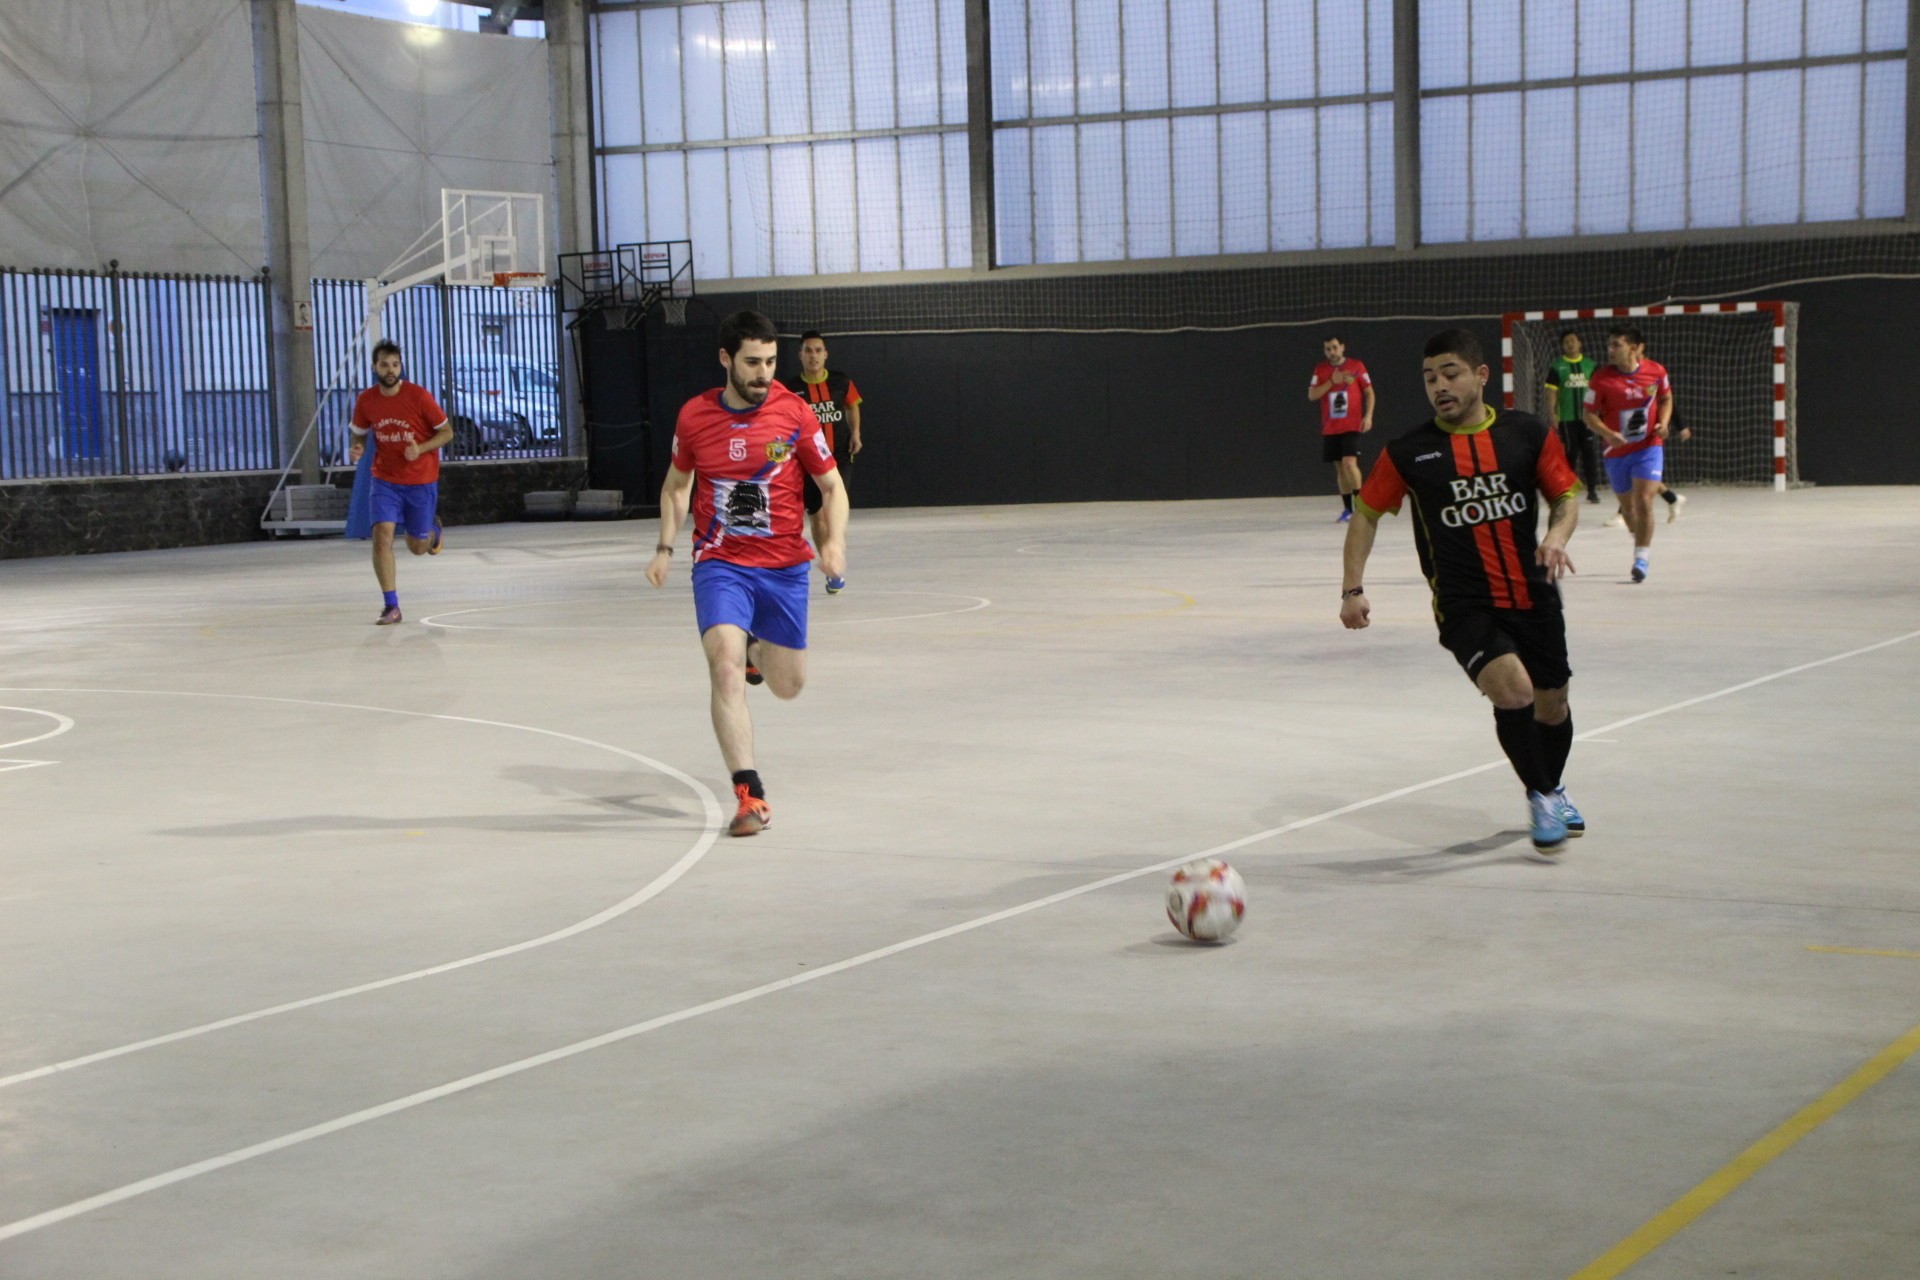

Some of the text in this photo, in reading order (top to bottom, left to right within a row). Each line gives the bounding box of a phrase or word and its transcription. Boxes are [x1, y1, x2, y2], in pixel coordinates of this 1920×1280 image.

[809, 400, 836, 413] BAR
[816, 410, 843, 423] OIKO
[729, 438, 747, 461] 5
[1449, 473, 1510, 502] BAR
[1440, 491, 1527, 527] GOIKO
